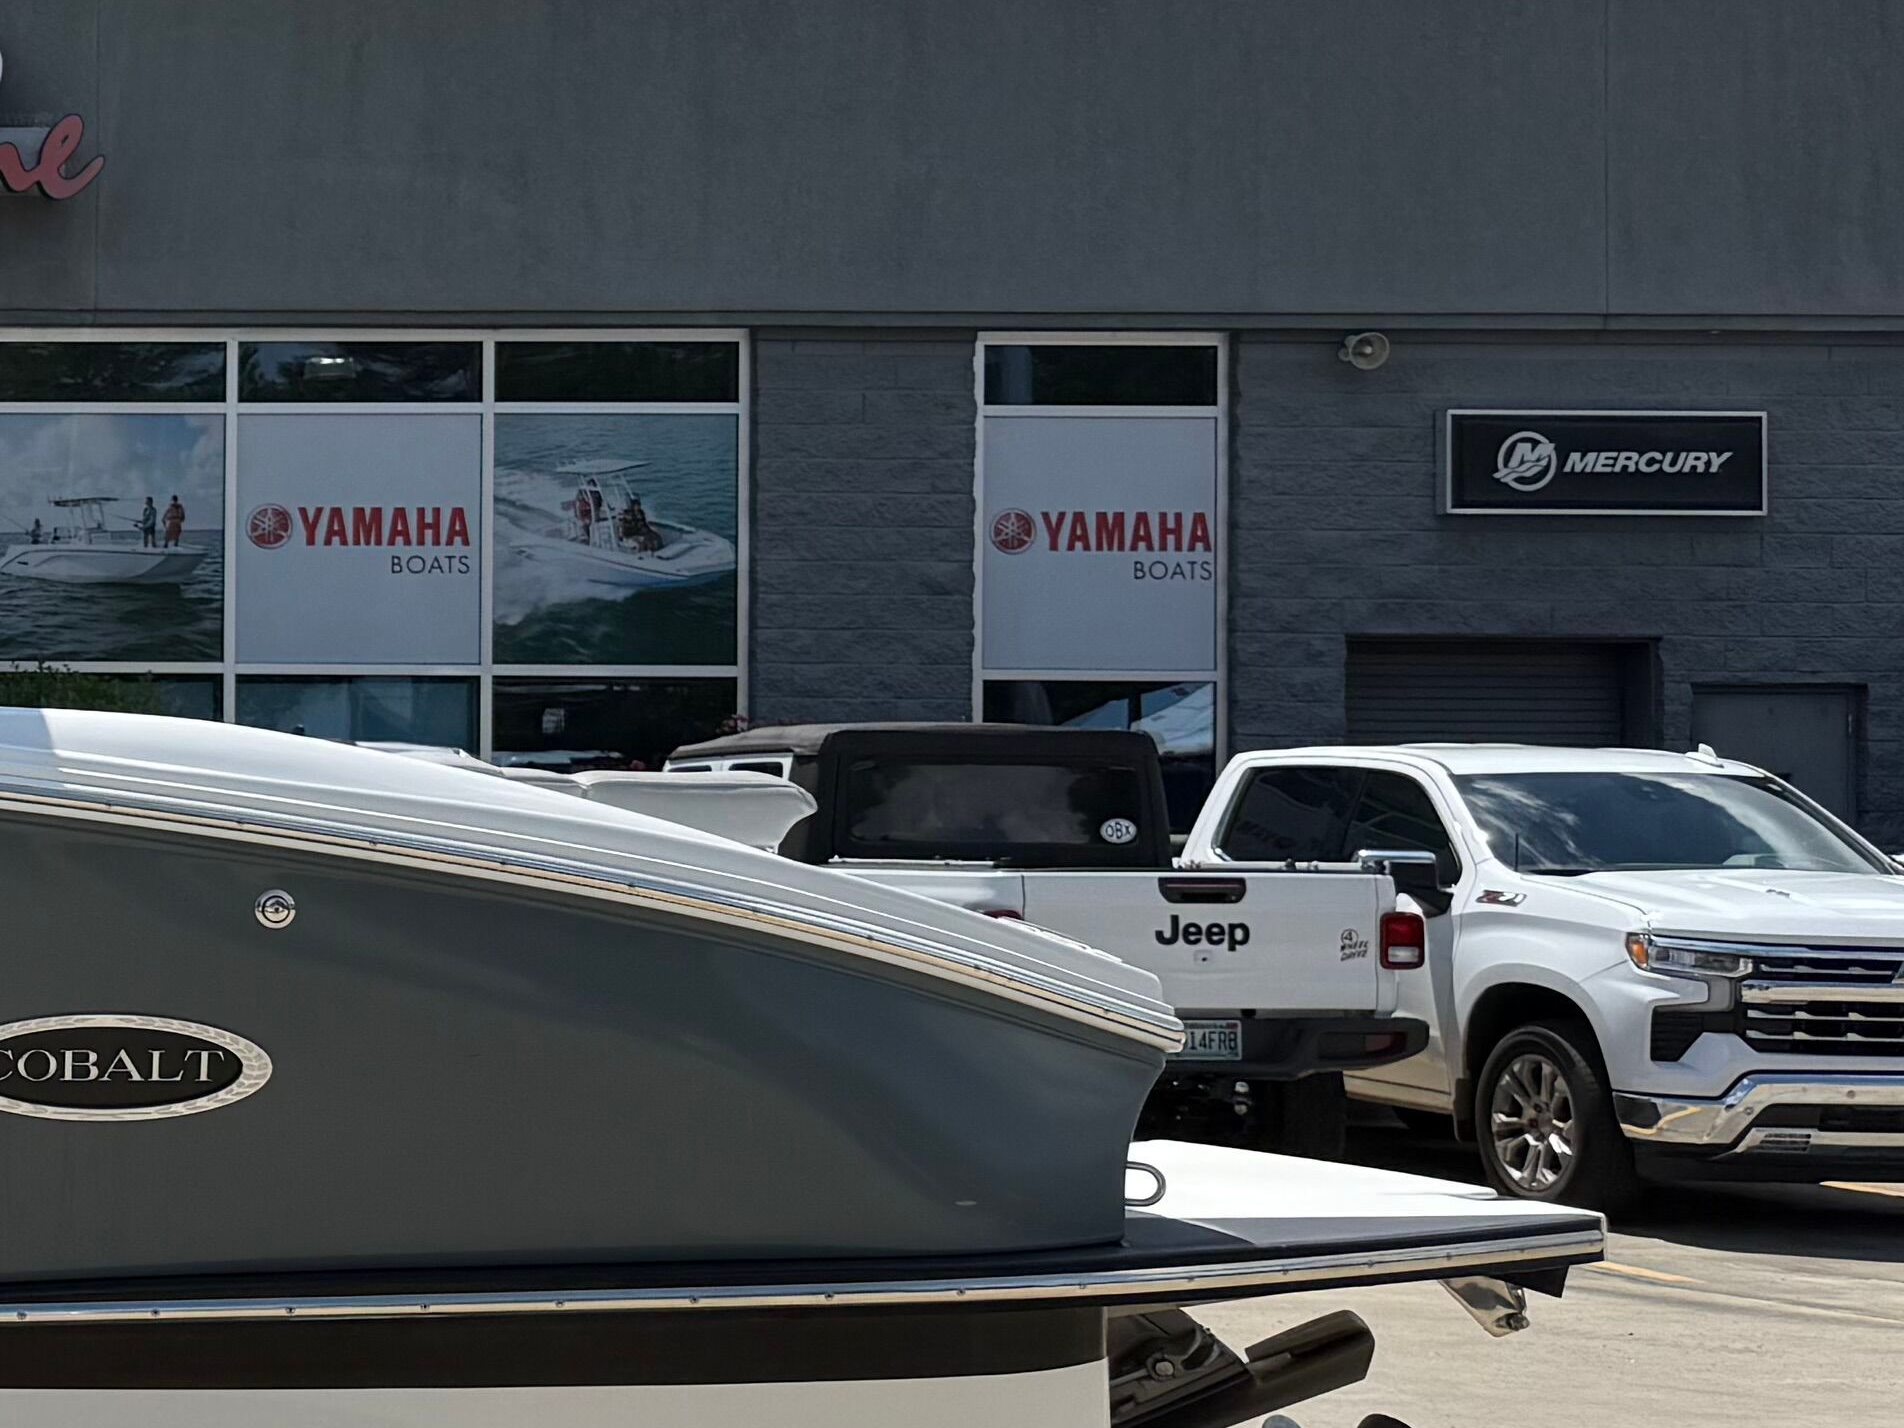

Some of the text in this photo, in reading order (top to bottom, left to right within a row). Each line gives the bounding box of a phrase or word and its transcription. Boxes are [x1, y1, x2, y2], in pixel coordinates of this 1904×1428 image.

[1563, 451, 1733, 473] MERCURY
[298, 505, 470, 547] YAMAHA
[1042, 511, 1213, 552] YAMAHA
[391, 554, 470, 575] BOATS
[1133, 560, 1213, 582] BOATS
[1106, 821, 1132, 839] OBX
[1155, 914, 1250, 952] Jeep
